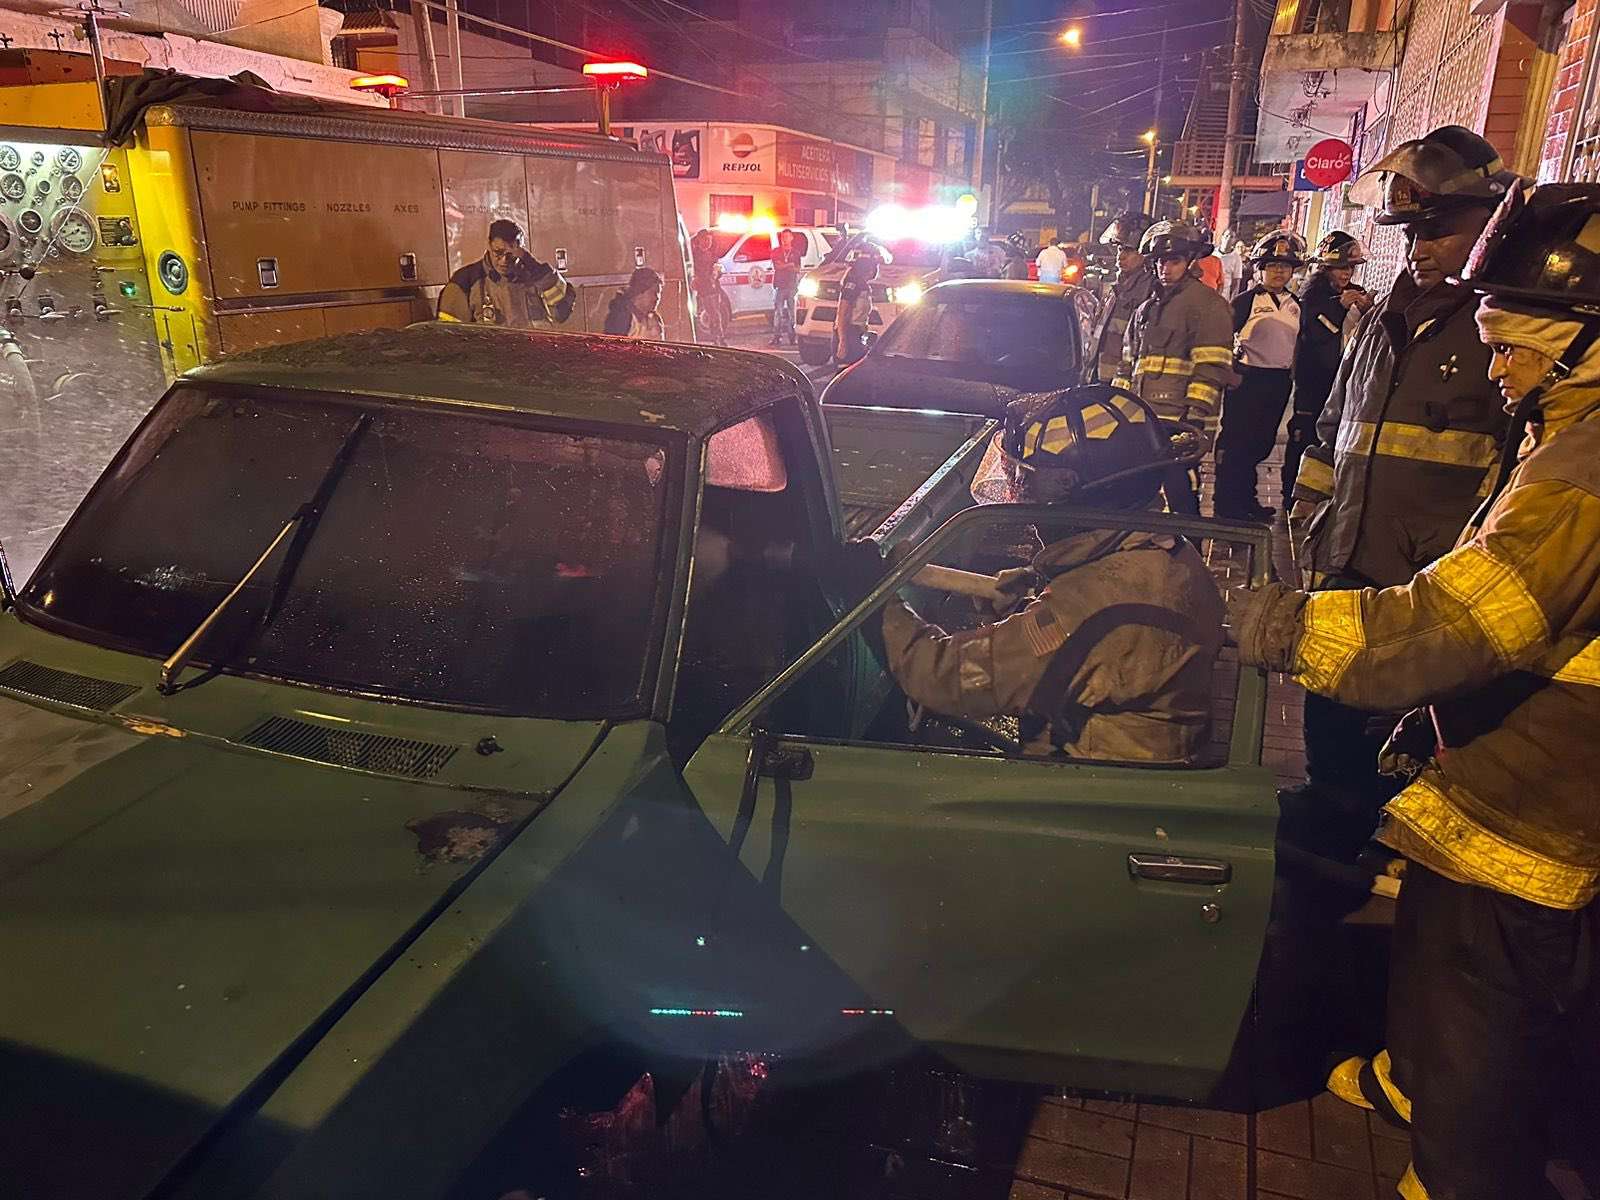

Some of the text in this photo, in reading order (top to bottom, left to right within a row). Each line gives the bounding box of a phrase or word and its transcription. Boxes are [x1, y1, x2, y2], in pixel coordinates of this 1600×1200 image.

[722, 162, 762, 172] REPSOL
[1306, 155, 1345, 169] Claro
[232, 200, 419, 213] PUMP FITTINGS NOZZLES AXES
